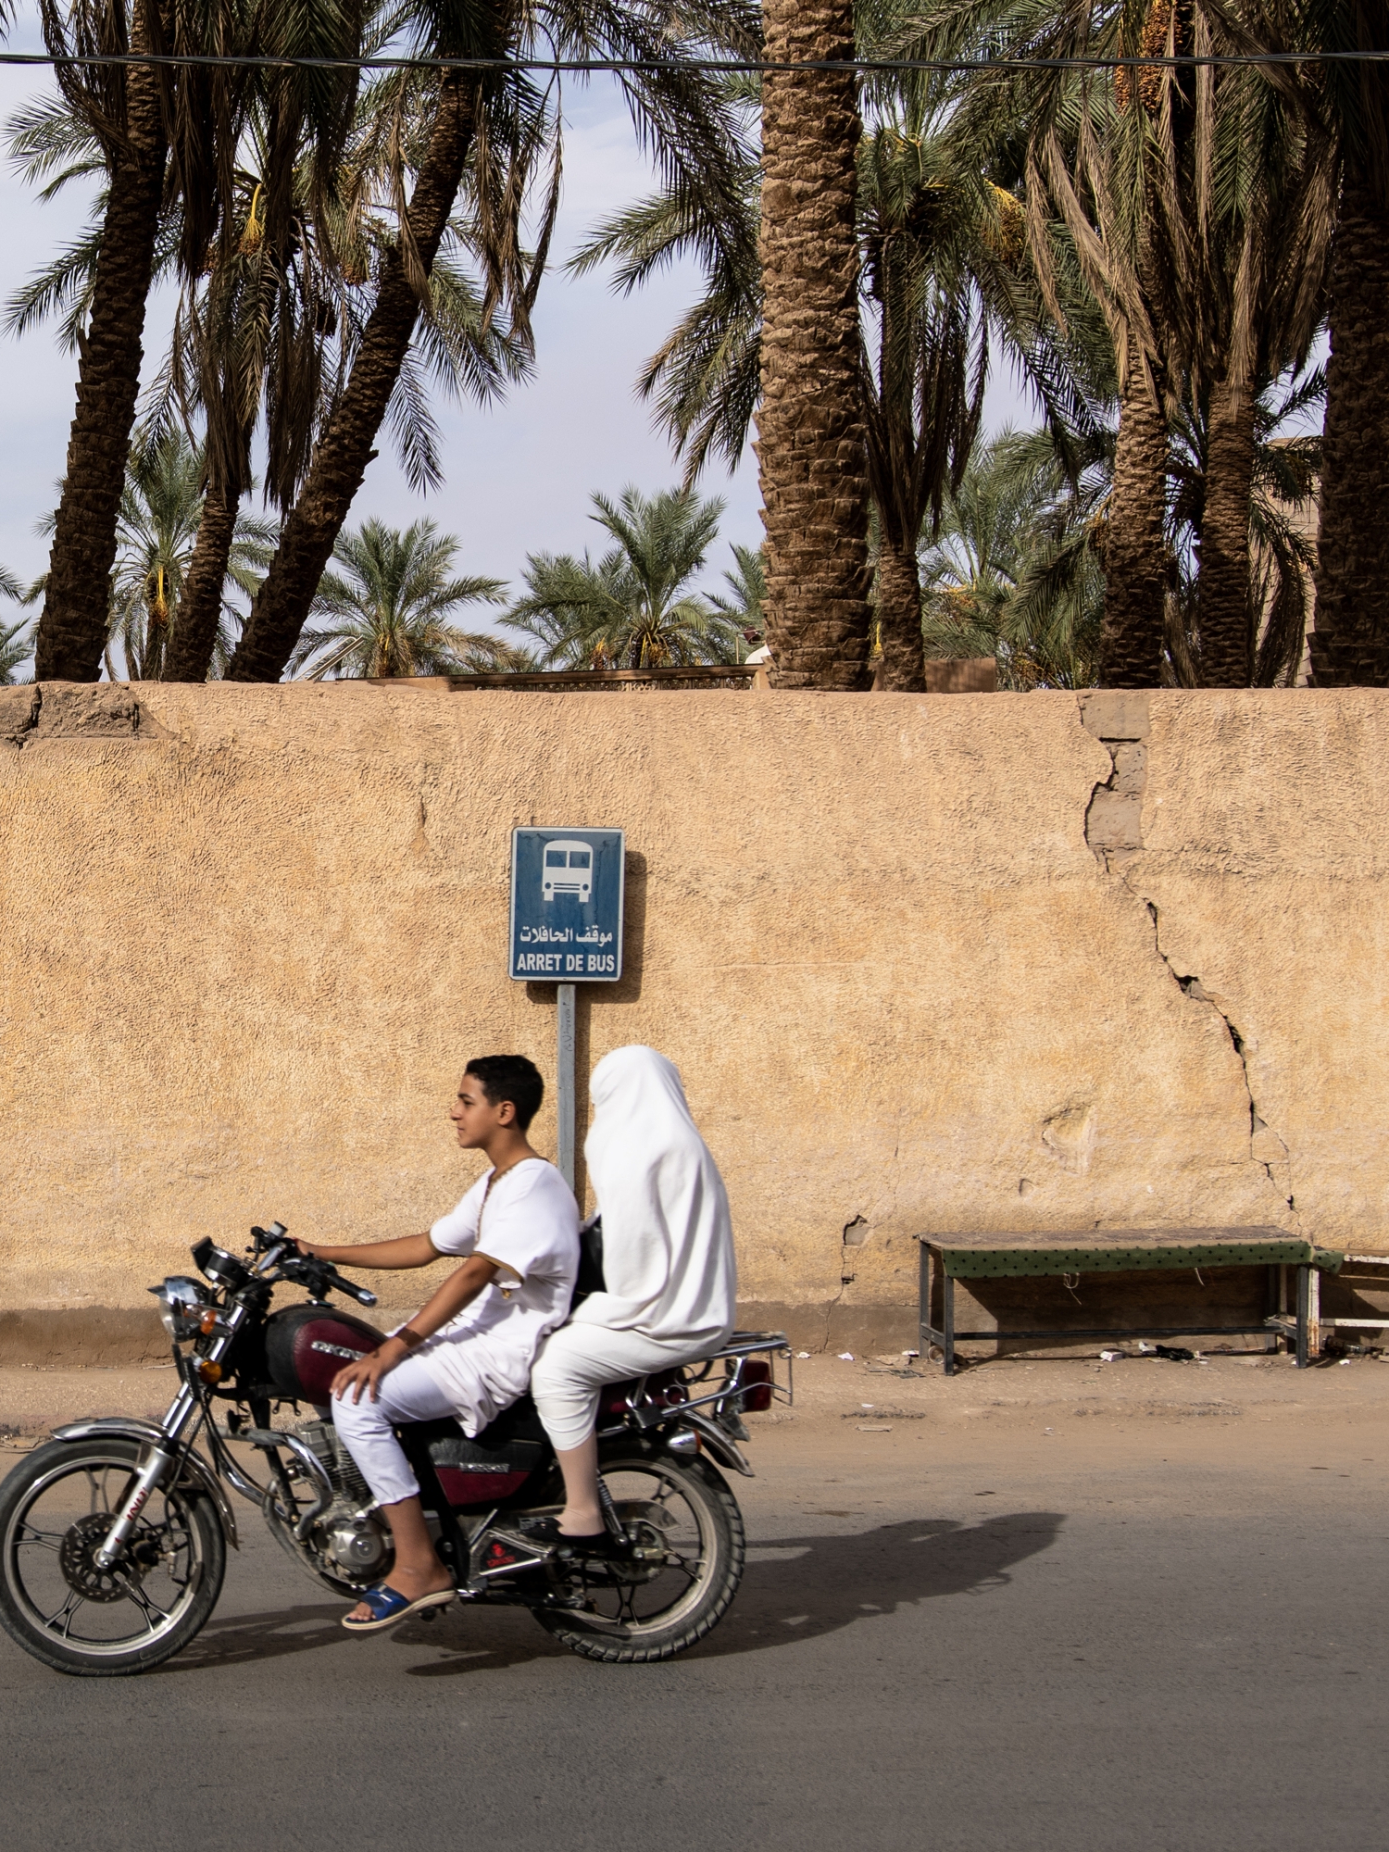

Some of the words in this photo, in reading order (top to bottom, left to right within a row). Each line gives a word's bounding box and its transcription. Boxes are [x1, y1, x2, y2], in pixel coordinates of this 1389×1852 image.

[520, 925, 573, 943] الحافلات
[575, 924, 613, 947] موقف
[516, 953, 562, 971] ARRET
[566, 954, 584, 971] DE
[587, 954, 615, 972] BUS
